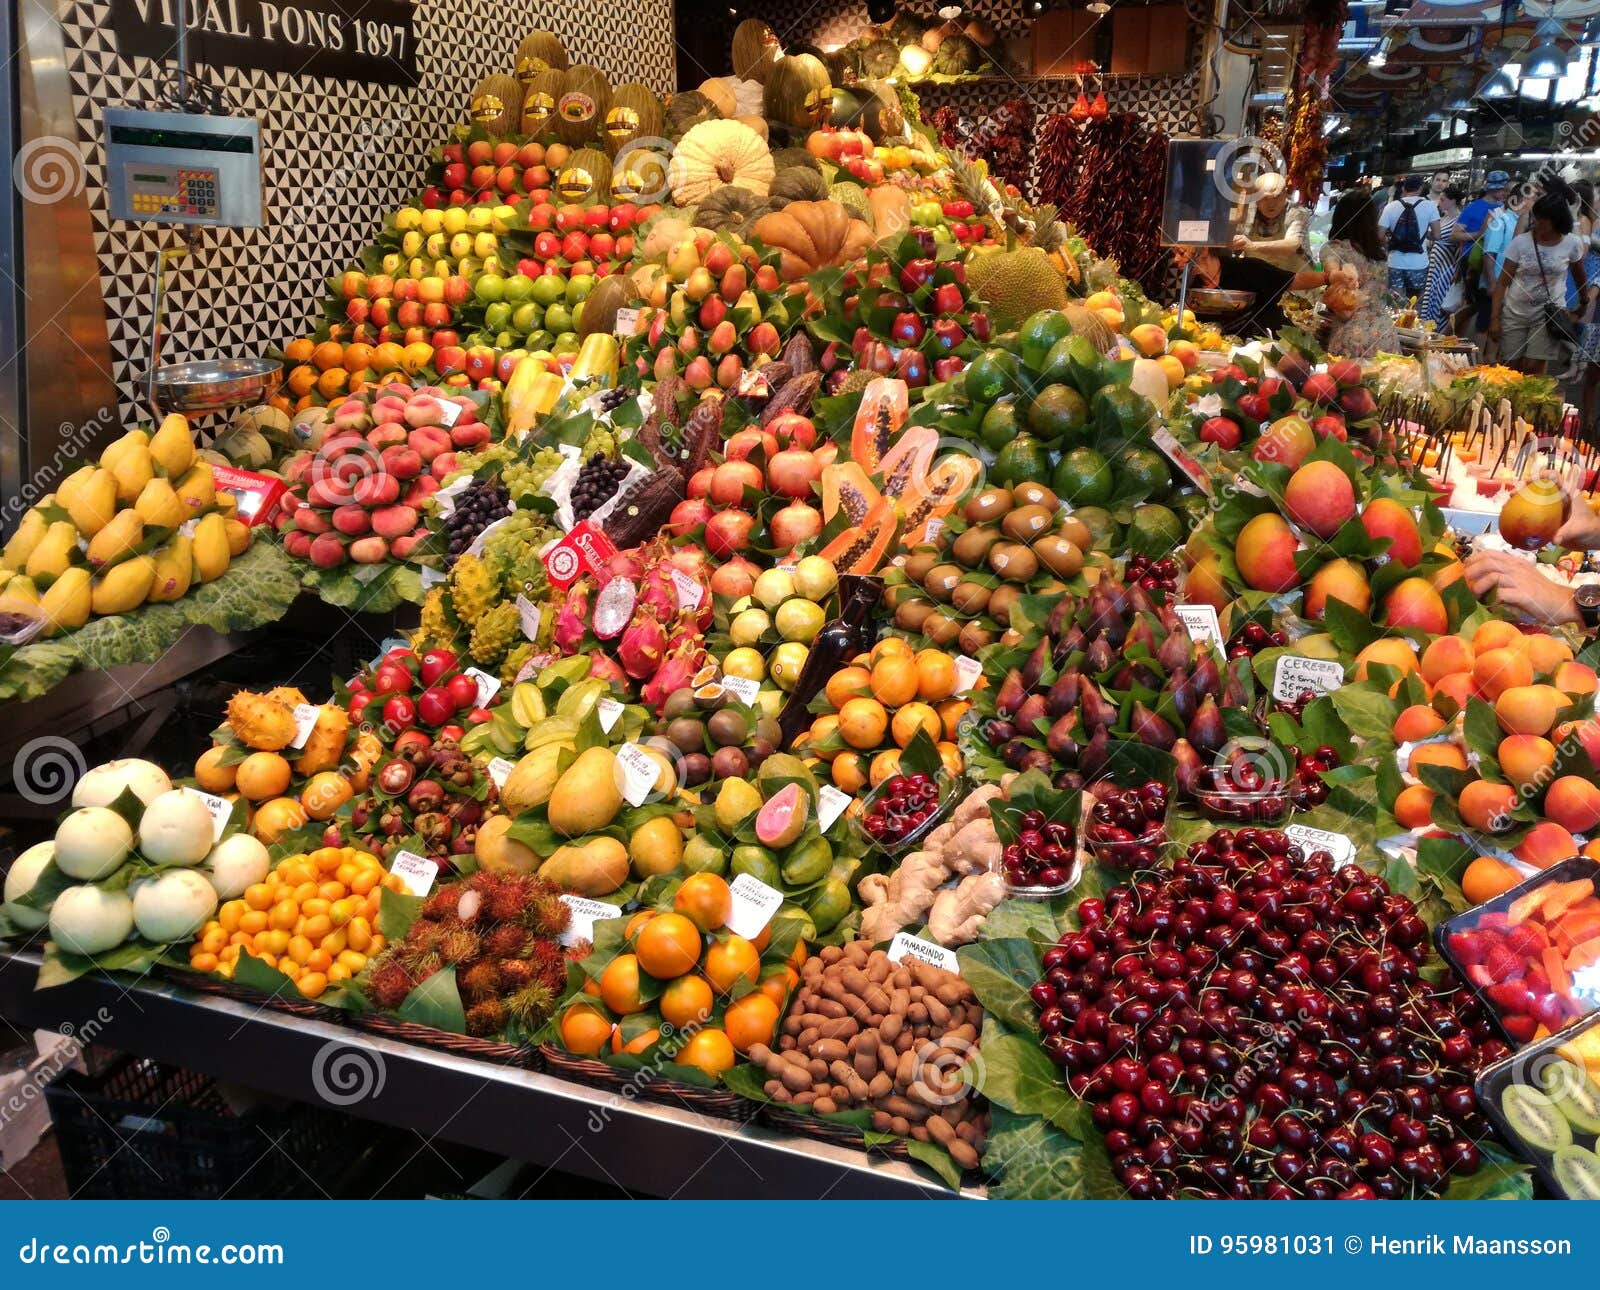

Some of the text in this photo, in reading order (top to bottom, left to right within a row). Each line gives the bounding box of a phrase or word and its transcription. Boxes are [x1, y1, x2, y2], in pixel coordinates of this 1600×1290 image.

[258, 1, 345, 51] PONS
[352, 18, 405, 60] 1897
[1283, 658, 1337, 674] CEREZA
[1289, 825, 1336, 843] CEREZA
